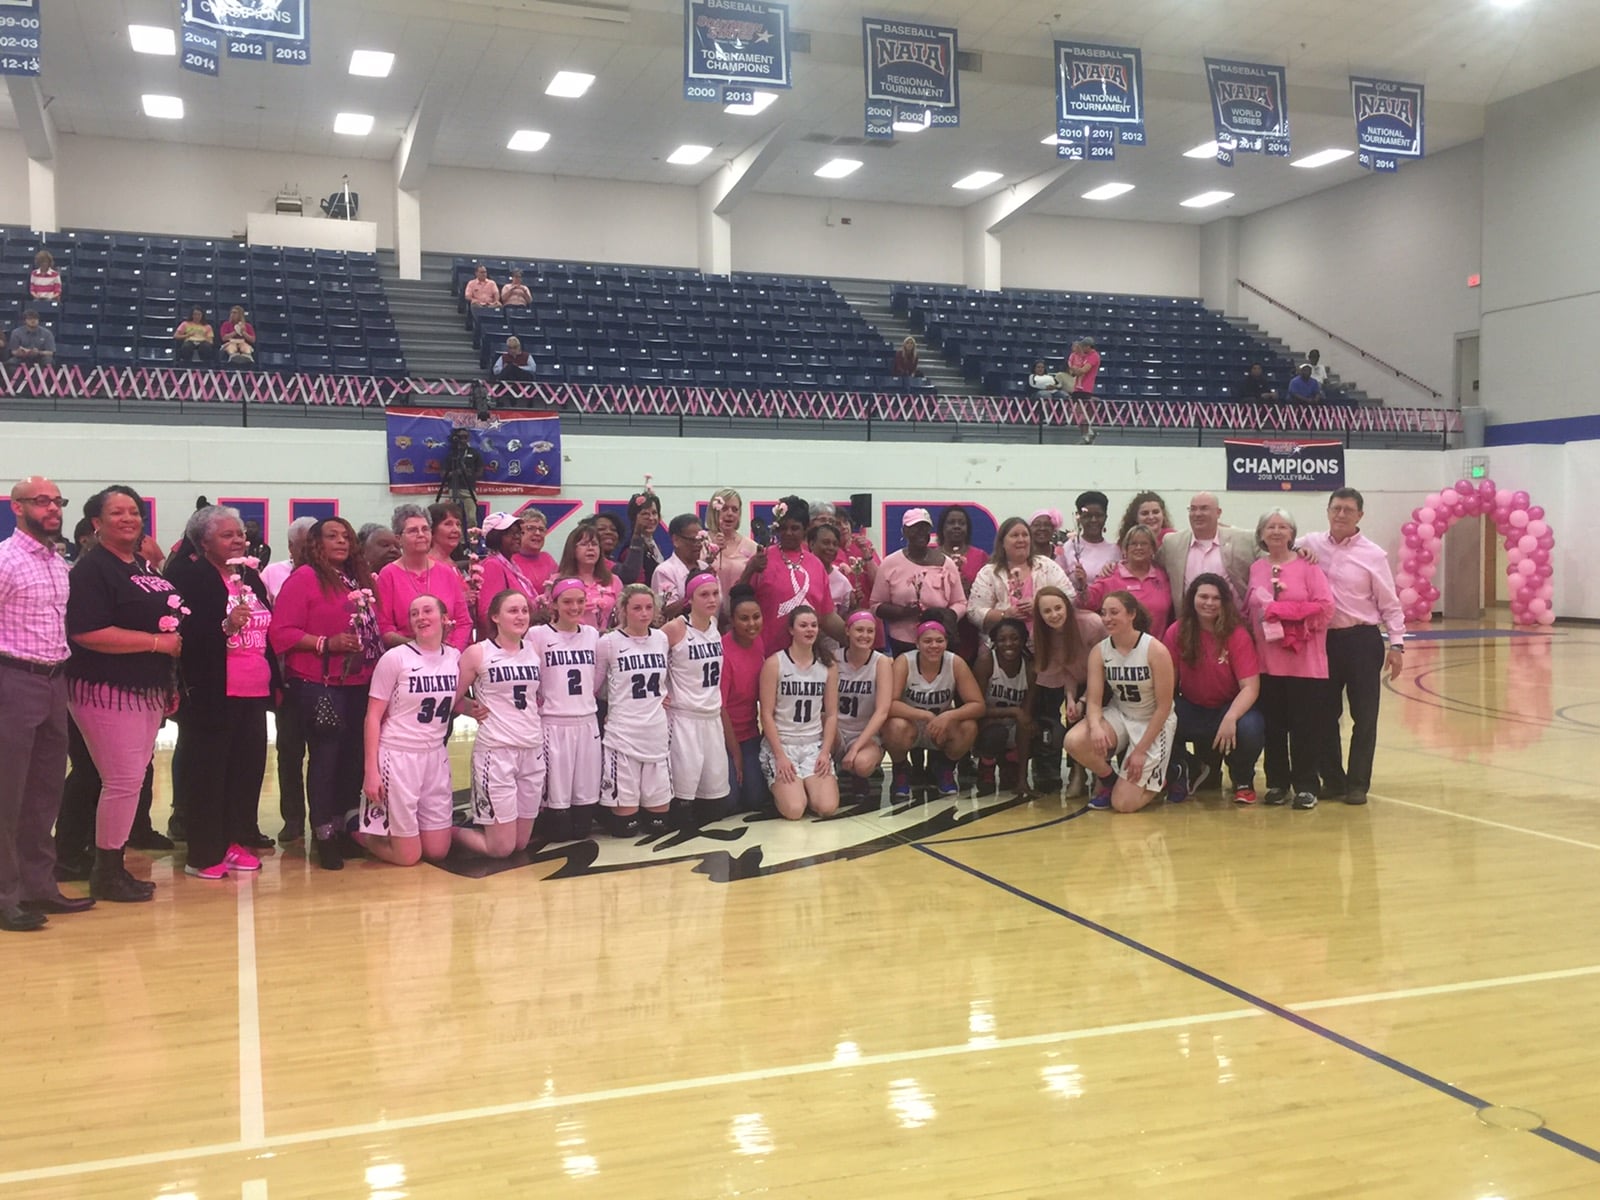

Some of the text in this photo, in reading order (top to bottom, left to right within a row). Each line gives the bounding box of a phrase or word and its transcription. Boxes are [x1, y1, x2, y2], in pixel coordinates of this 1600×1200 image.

[200, 1, 292, 24] CPIONS
[707, 0, 766, 14] BASEBALL
[883, 24, 937, 39] BASEBALL
[0, 36, 38, 49] 02-03
[184, 32, 307, 60] 2004 2012 2013
[184, 53, 216, 70] 2014
[701, 49, 775, 65] TOURNAMENT
[876, 37, 945, 75] NAIA
[1073, 47, 1123, 60] BASEBALL
[706, 60, 770, 74] CHAMPIONS
[1219, 64, 1267, 78] BASEBALL
[887, 74, 936, 88] REGIONAL
[1072, 60, 1128, 93] NAIA
[687, 87, 753, 102] 2000 2013
[880, 81, 945, 98] TOURNAMENT
[1375, 82, 1398, 93] GOLF
[1079, 92, 1122, 104] NATIONAL
[1217, 81, 1275, 111] NAIA
[867, 106, 958, 124] 2000 2002 2003
[1070, 101, 1131, 113] TOURNAMENT
[1231, 107, 1262, 118] WORLD
[1358, 93, 1413, 128] NAIA
[867, 123, 892, 135] 2004
[1232, 116, 1263, 126] SERIES
[1059, 128, 1143, 142] 2010 2011 2012
[1367, 126, 1405, 138] NATIONAL
[1058, 146, 1114, 157] 2013 2014
[1268, 143, 1289, 153] 2014
[1375, 159, 1395, 169] 2014
[1232, 457, 1339, 475] CHAMPIONS
[688, 641, 723, 660] FAULKNE
[567, 669, 583, 696] 2
[702, 661, 720, 688] 12
[631, 672, 662, 700] 24
[838, 679, 872, 695] ULKNER
[1116, 684, 1142, 703] 15
[513, 685, 528, 710] 5
[417, 696, 453, 724] 34
[793, 699, 812, 723] 11
[839, 696, 859, 718] 31
